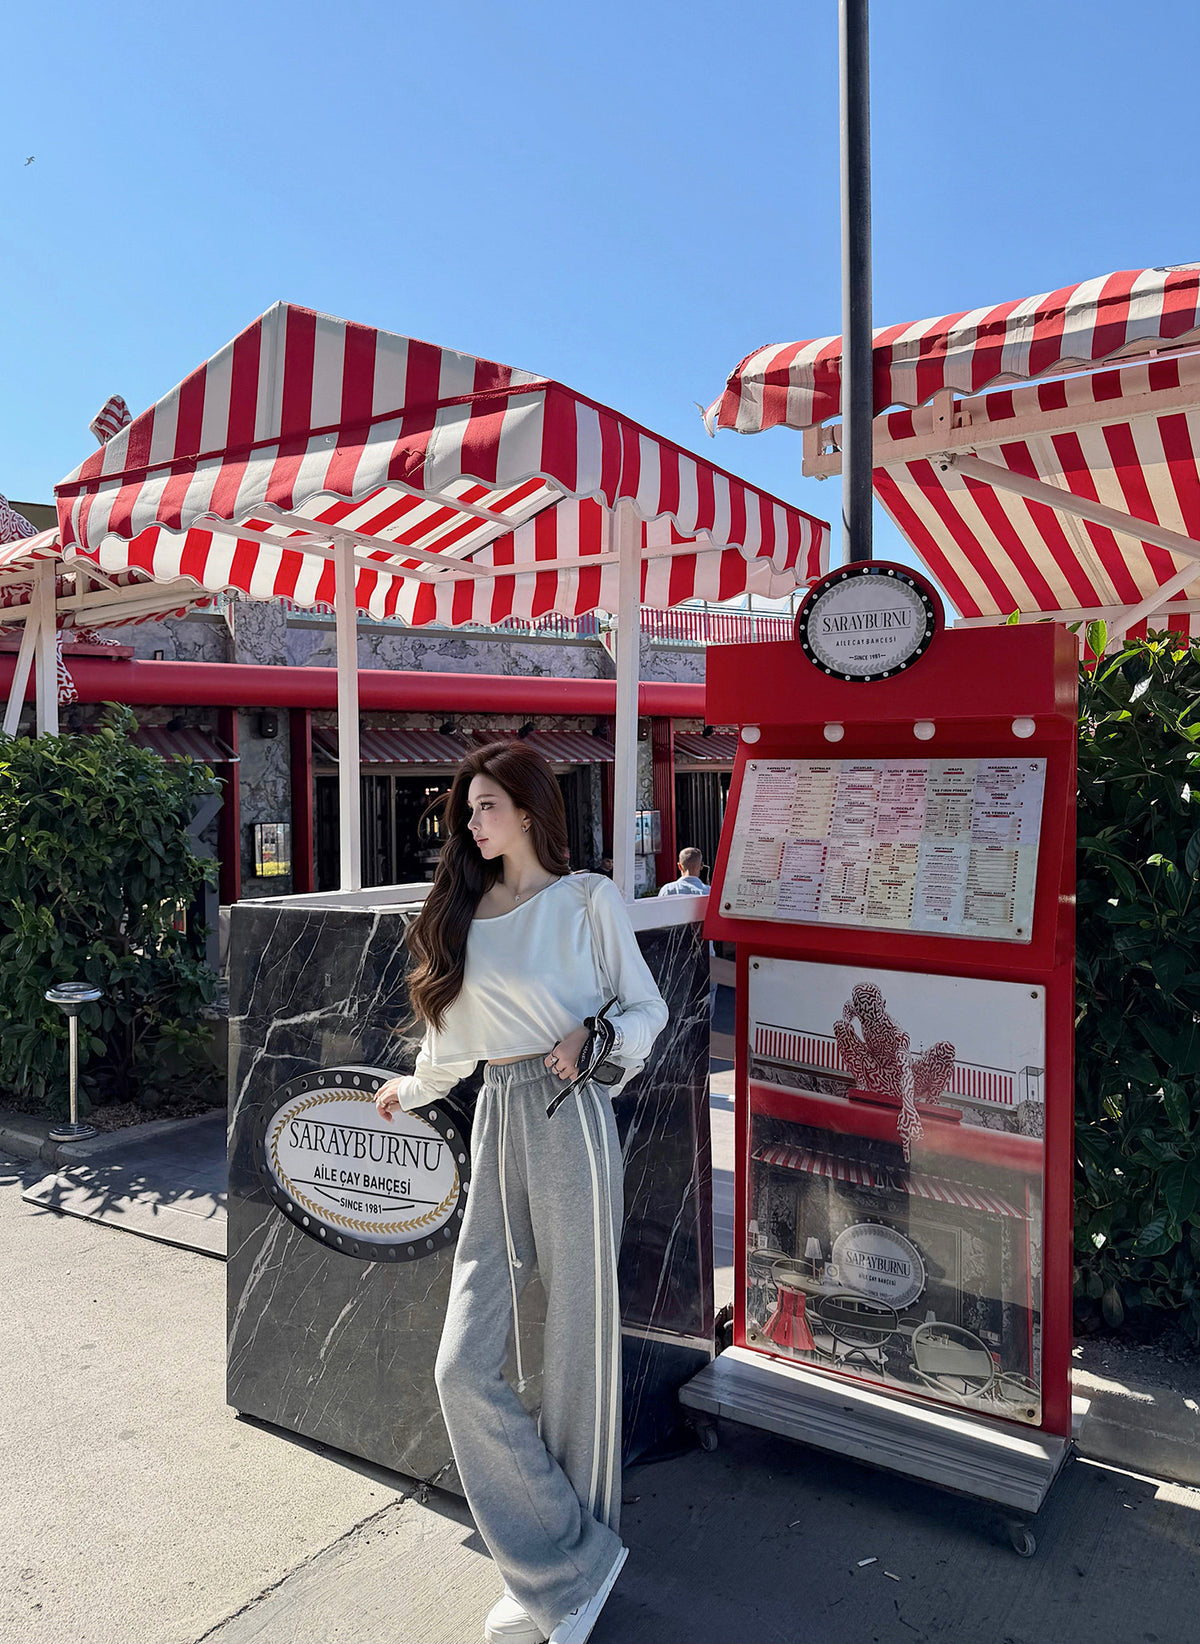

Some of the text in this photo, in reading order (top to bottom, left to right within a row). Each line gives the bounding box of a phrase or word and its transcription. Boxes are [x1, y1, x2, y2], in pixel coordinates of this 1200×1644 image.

[822, 610, 912, 633] SARAYBURNU
[289, 1121, 444, 1171] SARAYBURNU
[313, 1163, 411, 1195] AİLE ÇAY BAHÇESİ
[340, 1197, 382, 1214] SINCE 1981
[846, 1250, 910, 1276] SARAYBURNU
